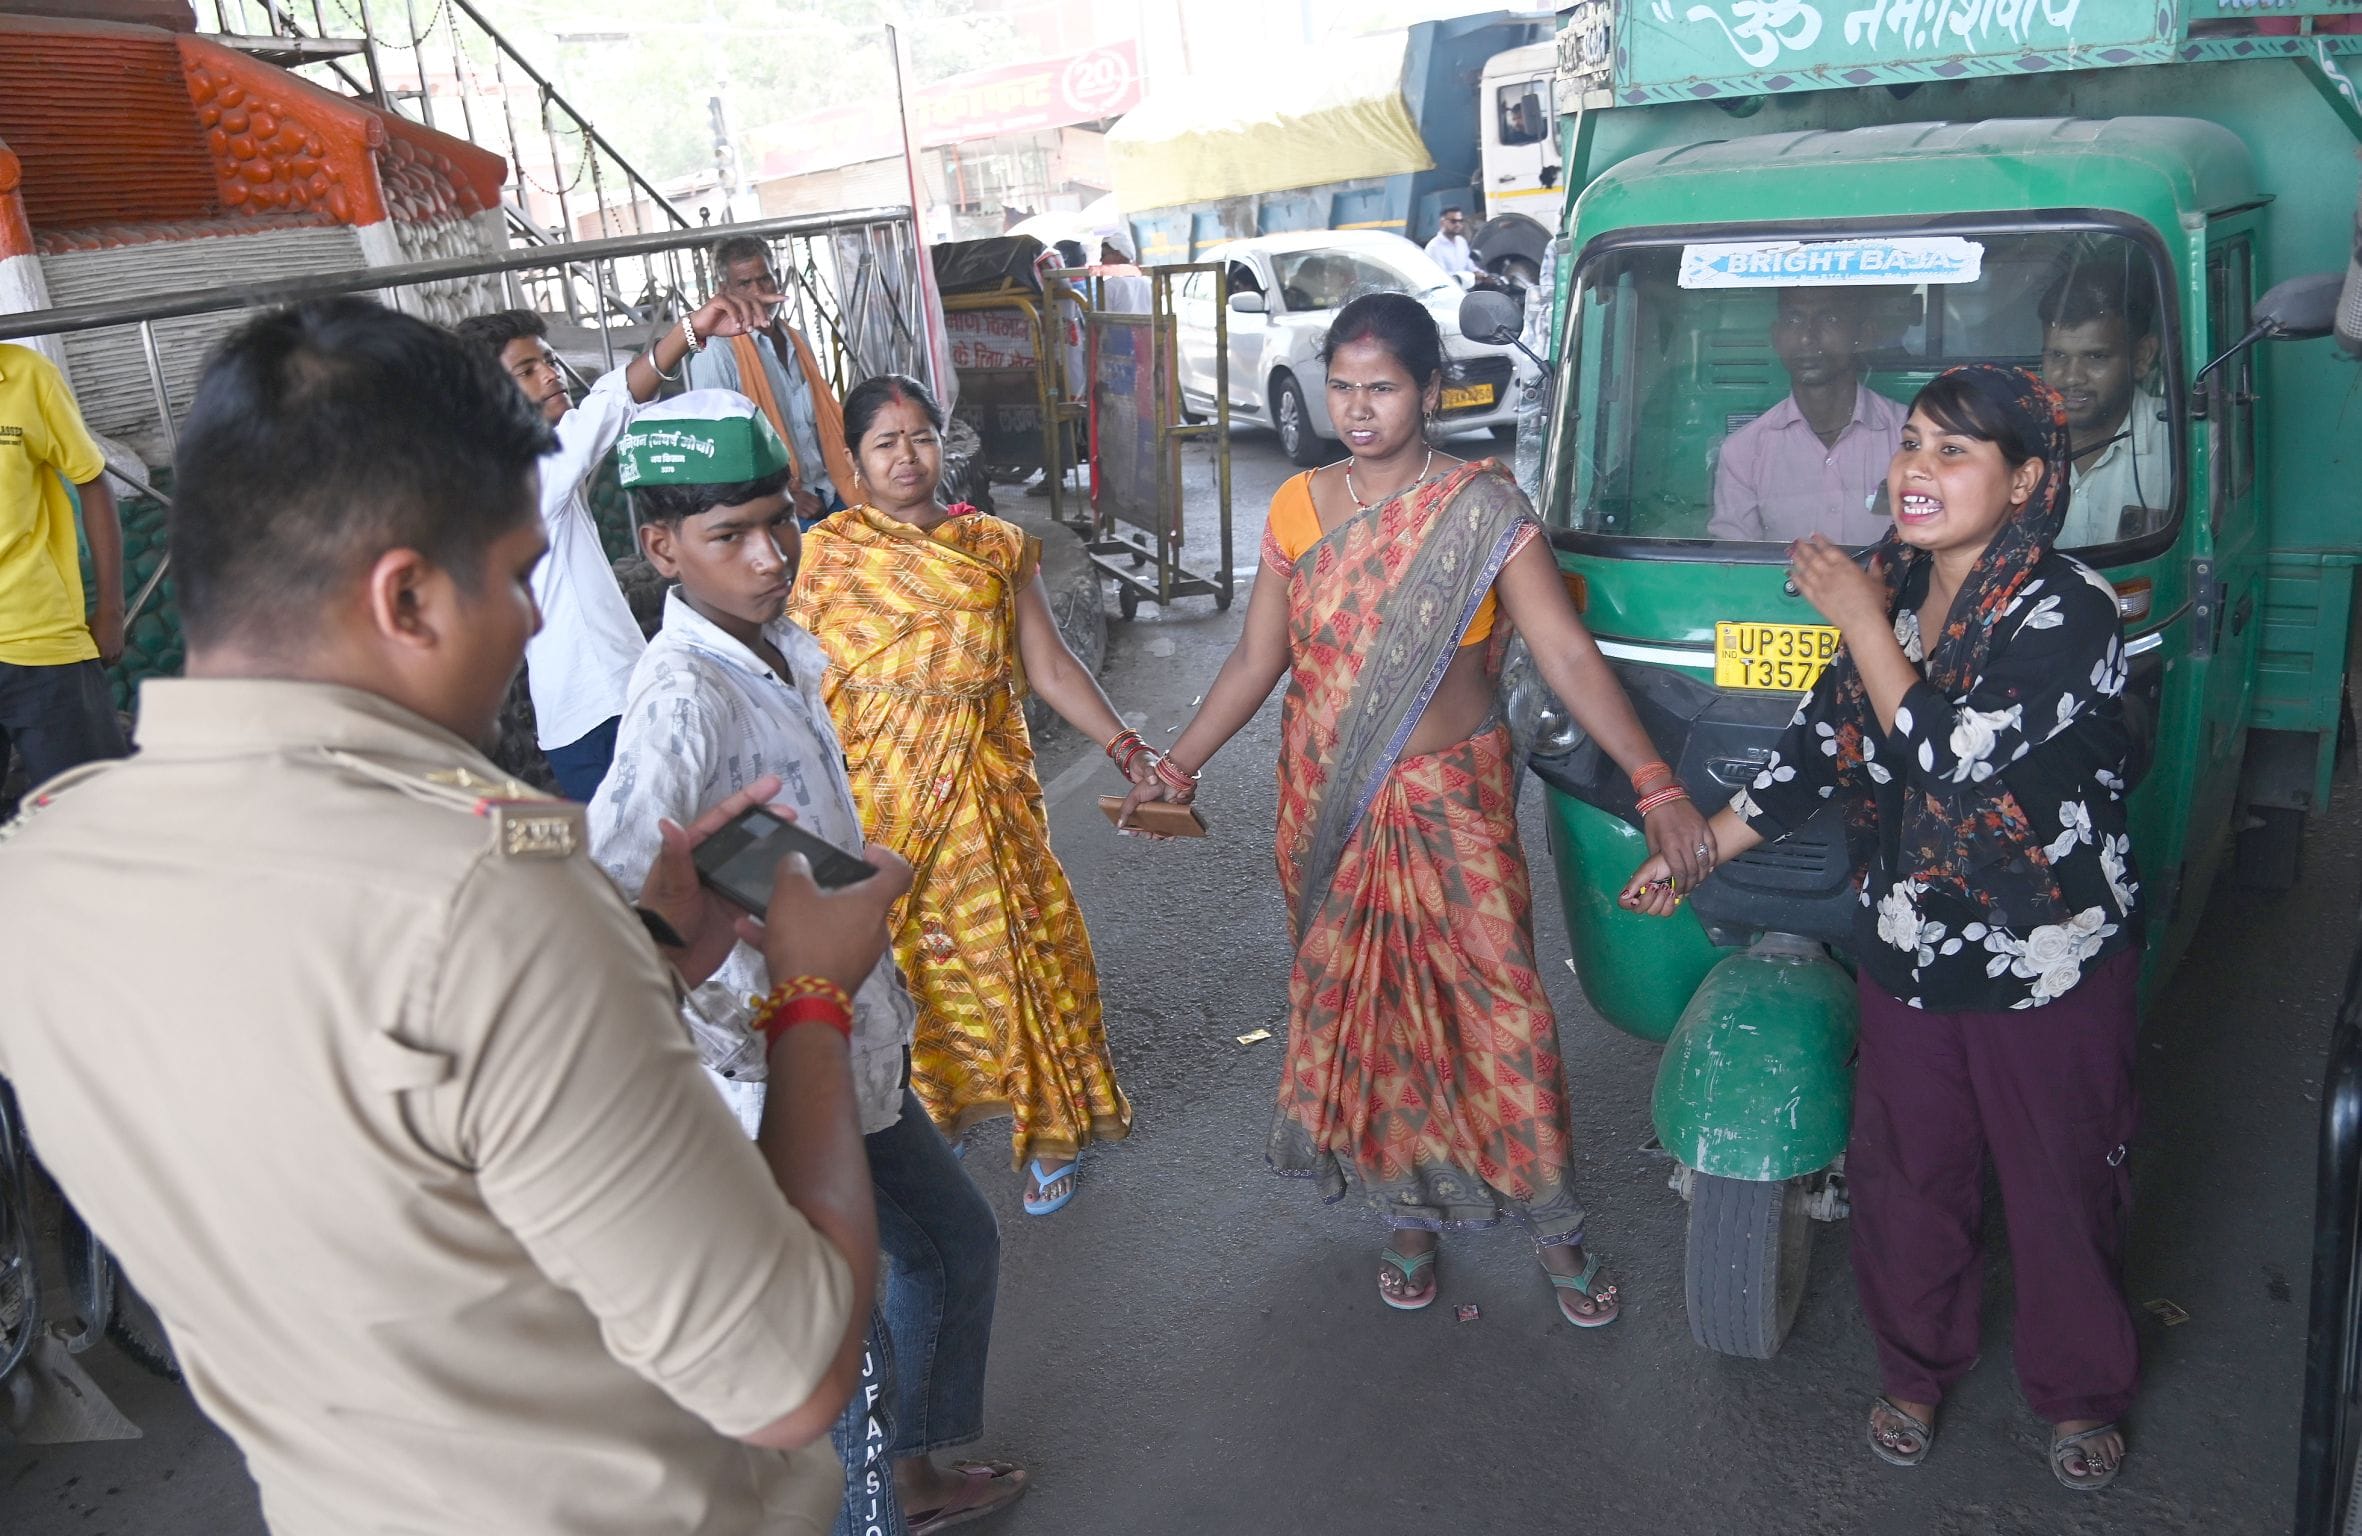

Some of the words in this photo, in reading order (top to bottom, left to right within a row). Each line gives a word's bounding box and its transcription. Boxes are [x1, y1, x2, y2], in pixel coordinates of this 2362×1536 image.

[1726, 250, 1857, 273] BRIGHT
[1721, 650, 1737, 659] IND
[1740, 628, 1835, 660] UP35B
[1740, 658, 1827, 689] T357
